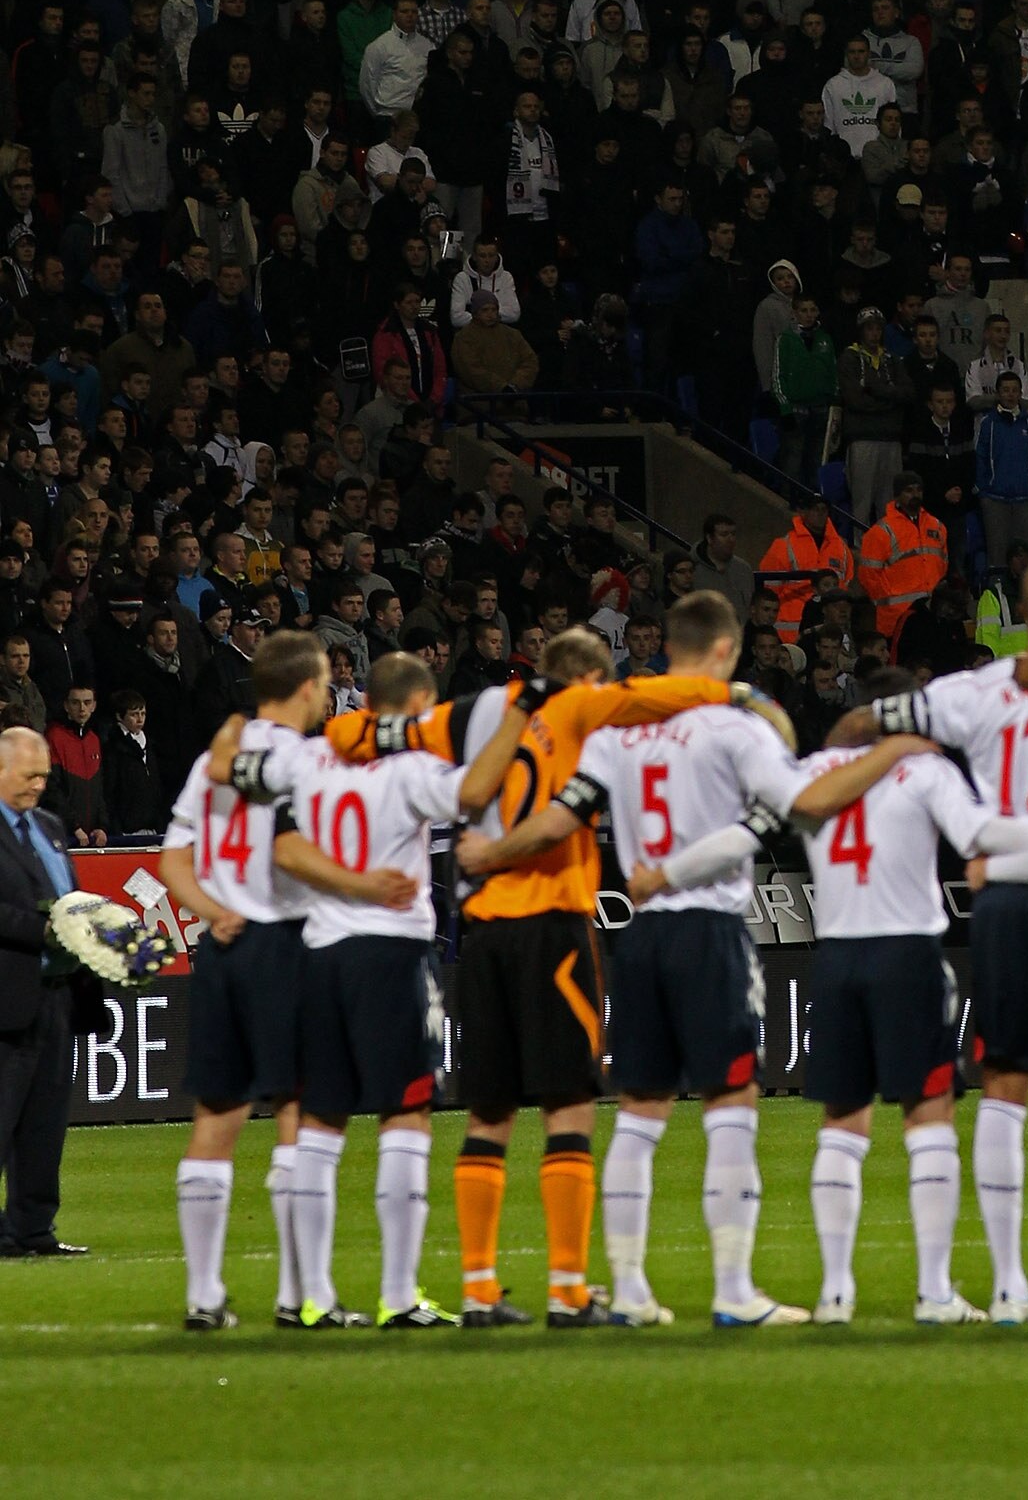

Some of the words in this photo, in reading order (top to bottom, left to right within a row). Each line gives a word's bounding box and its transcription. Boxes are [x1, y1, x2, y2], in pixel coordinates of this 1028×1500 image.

[200, 787, 252, 884] 14
[309, 789, 370, 874] 10
[641, 764, 674, 859] 5
[828, 798, 874, 886] 4
[72, 996, 170, 1103] BE
